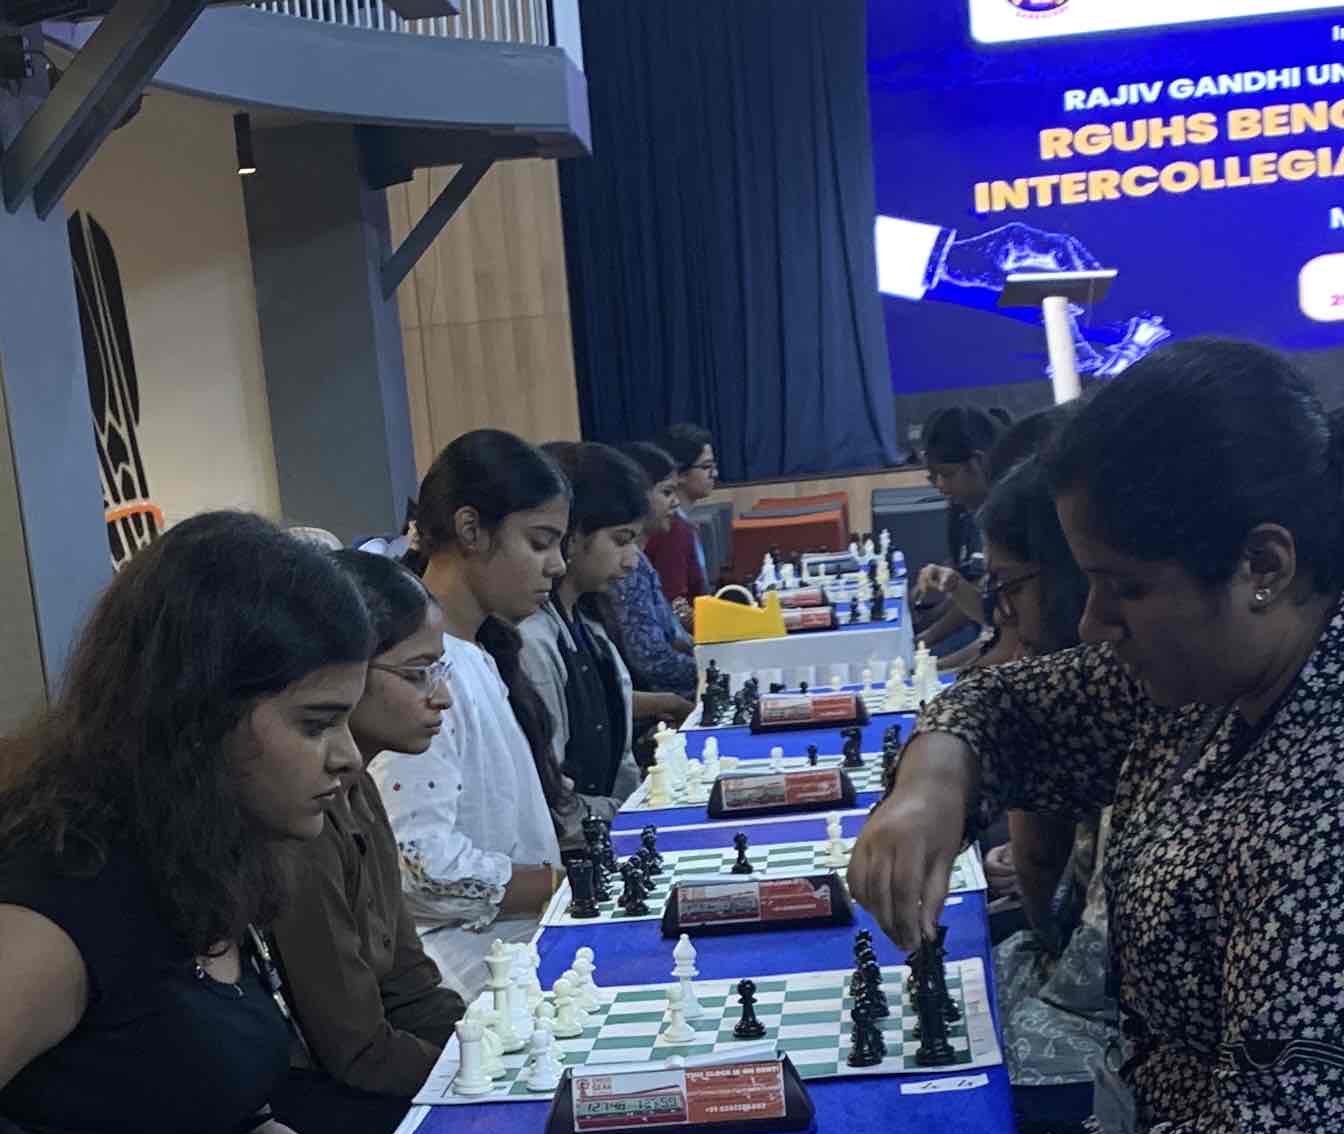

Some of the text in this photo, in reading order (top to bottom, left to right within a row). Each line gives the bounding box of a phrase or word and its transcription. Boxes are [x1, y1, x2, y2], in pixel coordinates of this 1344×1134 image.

[1063, 80, 1164, 111] RAJIV
[1167, 66, 1301, 100] GANDHI
[1039, 112, 1219, 161] RGUHS
